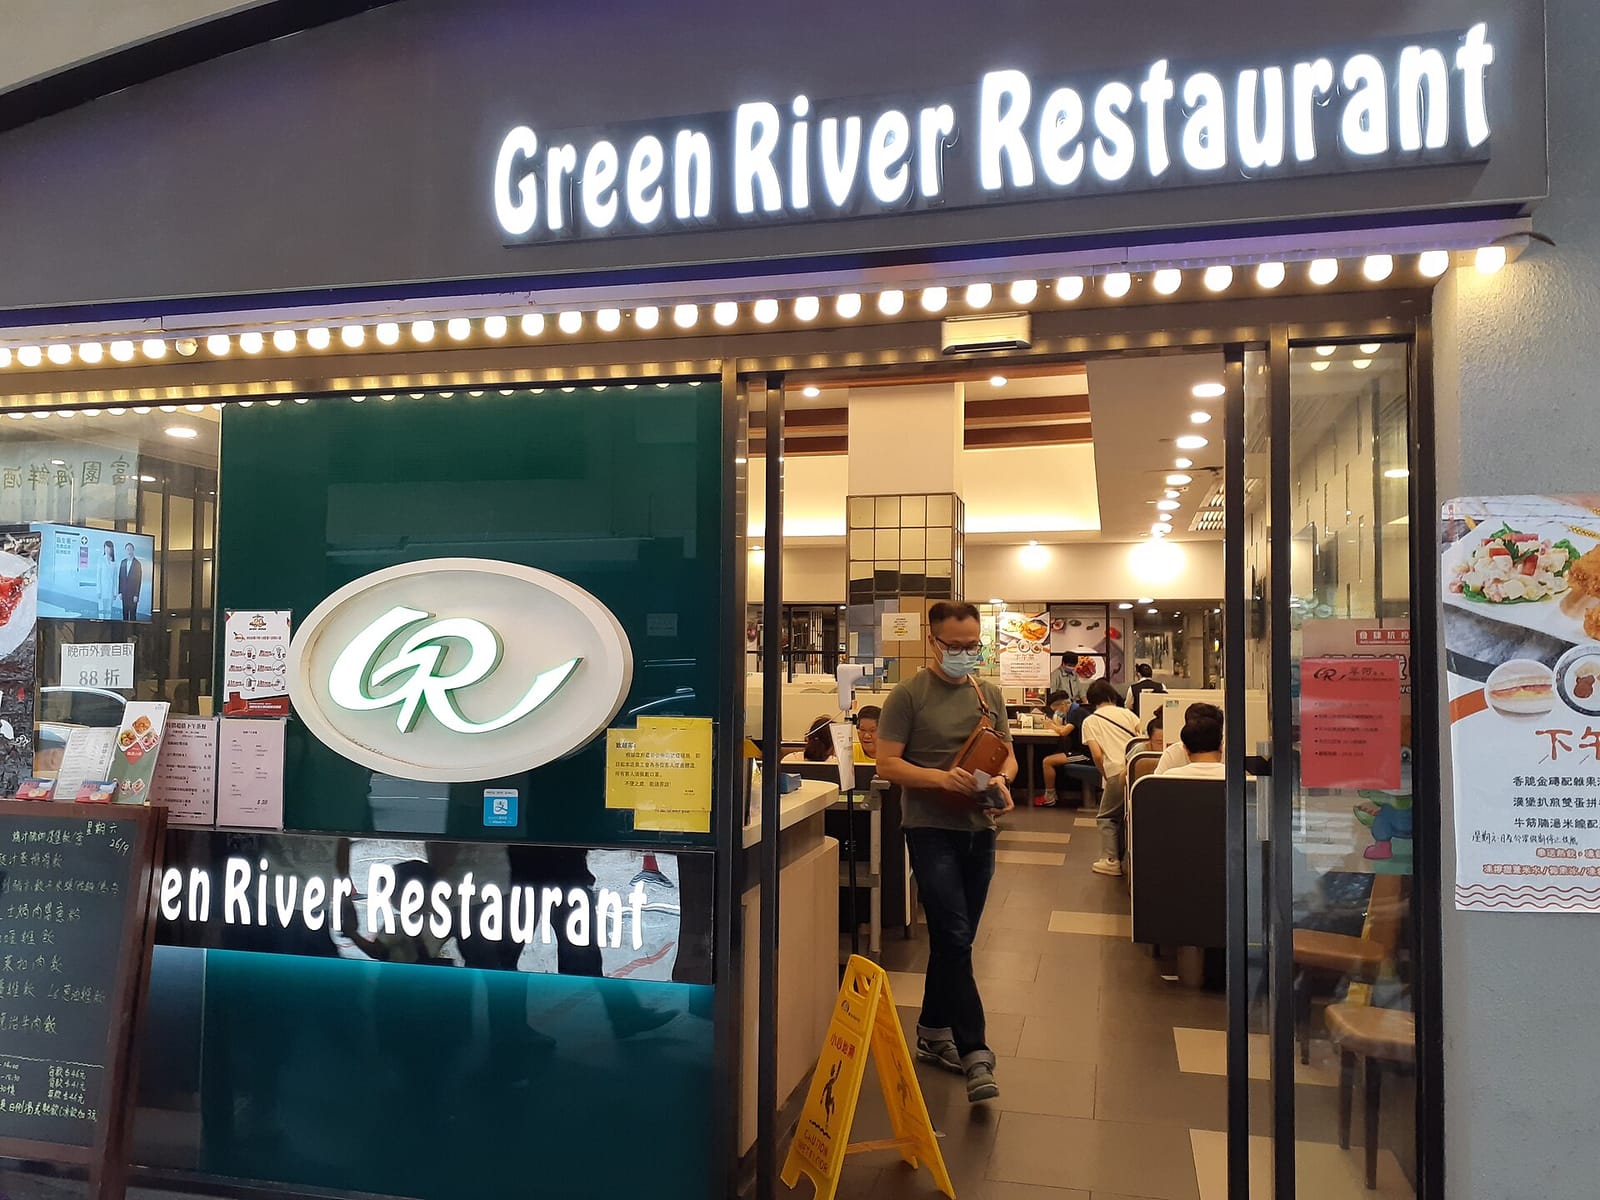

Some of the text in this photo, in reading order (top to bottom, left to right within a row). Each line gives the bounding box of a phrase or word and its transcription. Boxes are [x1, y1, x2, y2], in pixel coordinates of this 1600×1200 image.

[494, 21, 1496, 236] Green River Restaurant
[67, 644, 134, 658] 晚市外賣自取
[79, 668, 120, 687] 88 折
[1513, 797, 1600, 808] 漢堡扒煎雙蛋拼
[86, 820, 118, 836] 星期六
[1514, 817, 1600, 830] 牛筋腩湯米線配
[109, 837, 130, 856] 26/9
[223, 856, 353, 931] River
[366, 861, 648, 951] Restaurant
